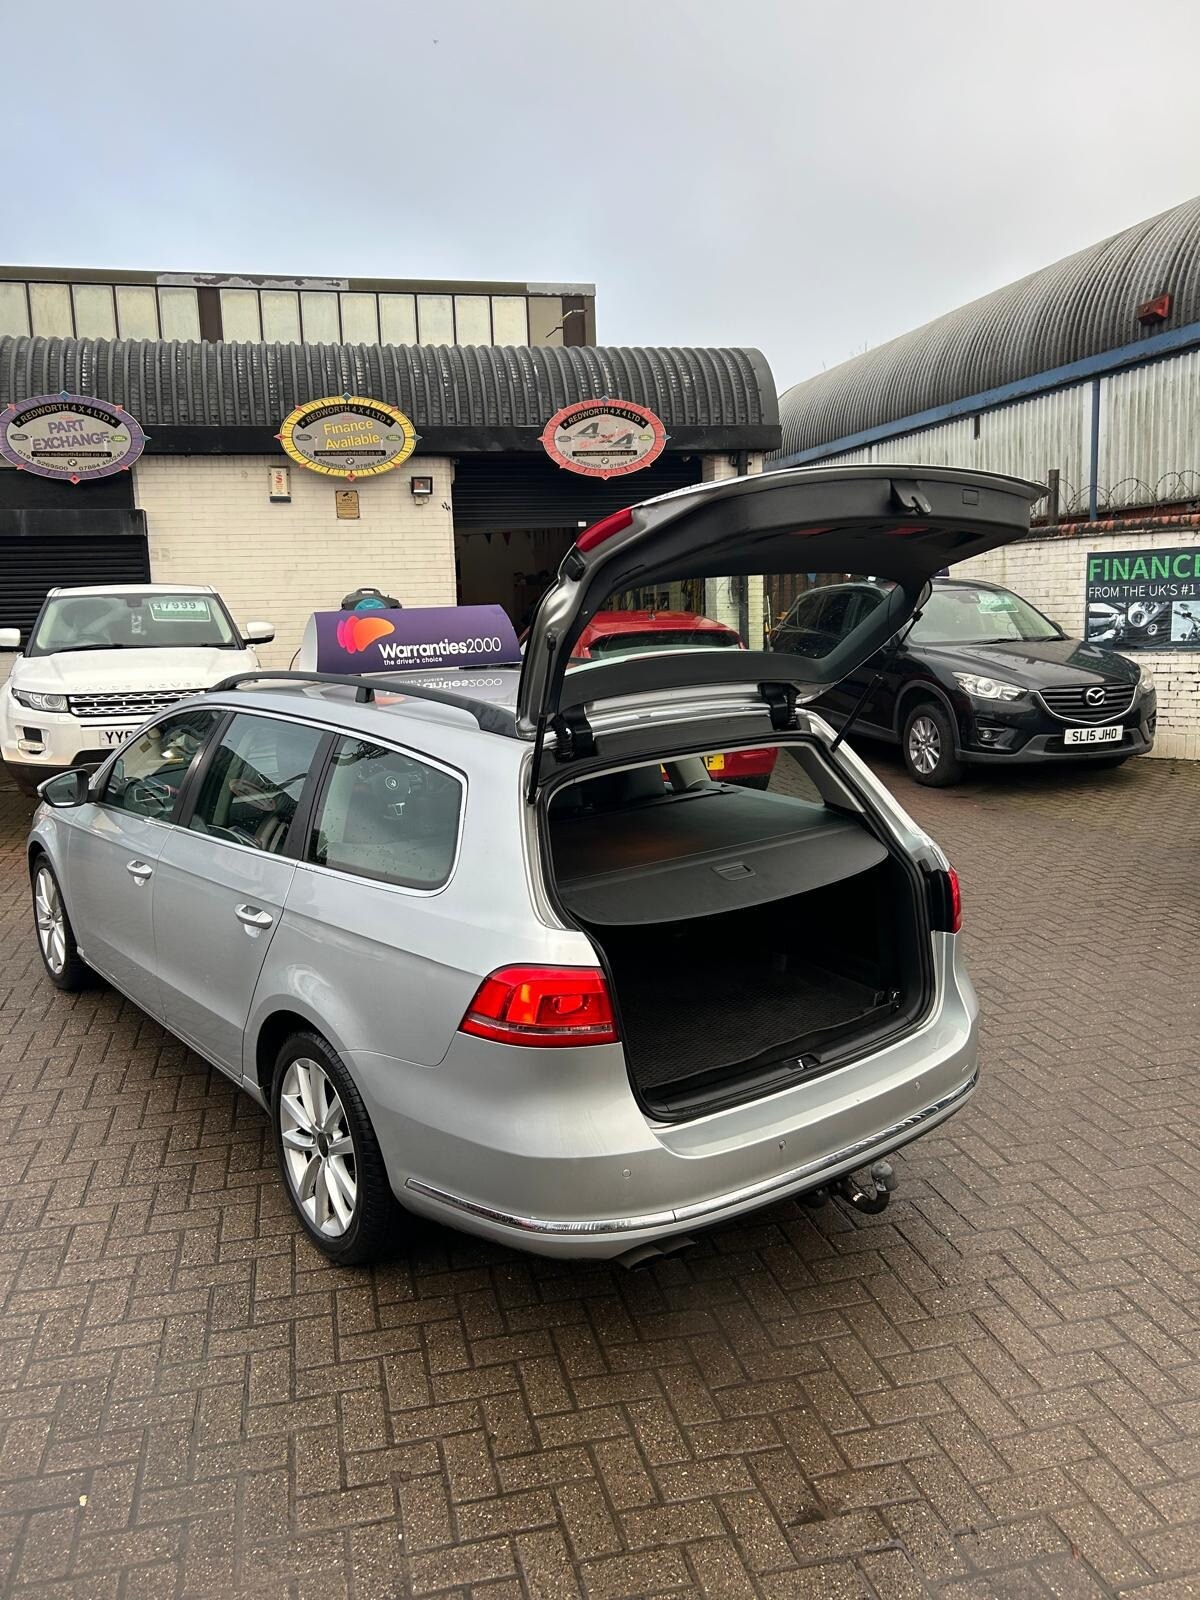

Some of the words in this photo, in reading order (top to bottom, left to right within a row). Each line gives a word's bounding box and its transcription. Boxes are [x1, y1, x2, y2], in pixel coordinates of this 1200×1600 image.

[21, 404, 69, 423] REDWORTH
[79, 405, 85, 413] X
[93, 410, 110, 422] LTD
[305, 405, 350, 423] REDWORTH
[371, 411, 386, 422] LTD
[568, 407, 609, 424] REDWORTH
[627, 412, 641, 423] LTD
[47, 419, 85, 434] PART
[323, 420, 374, 435] Finance
[32, 431, 111, 450] EXCHANGE
[325, 433, 380, 450] Available
[17, 449, 34, 462] 0191
[1088, 586, 1119, 598] FROM
[1122, 585, 1146, 597] THE
[1149, 583, 1178, 596] UK'S
[1181, 583, 1196, 595] #1
[378, 637, 502, 659] Warranties2000
[396, 657, 420, 665] driver's
[422, 656, 443, 664] choice
[1072, 730, 1096, 742] SL15
